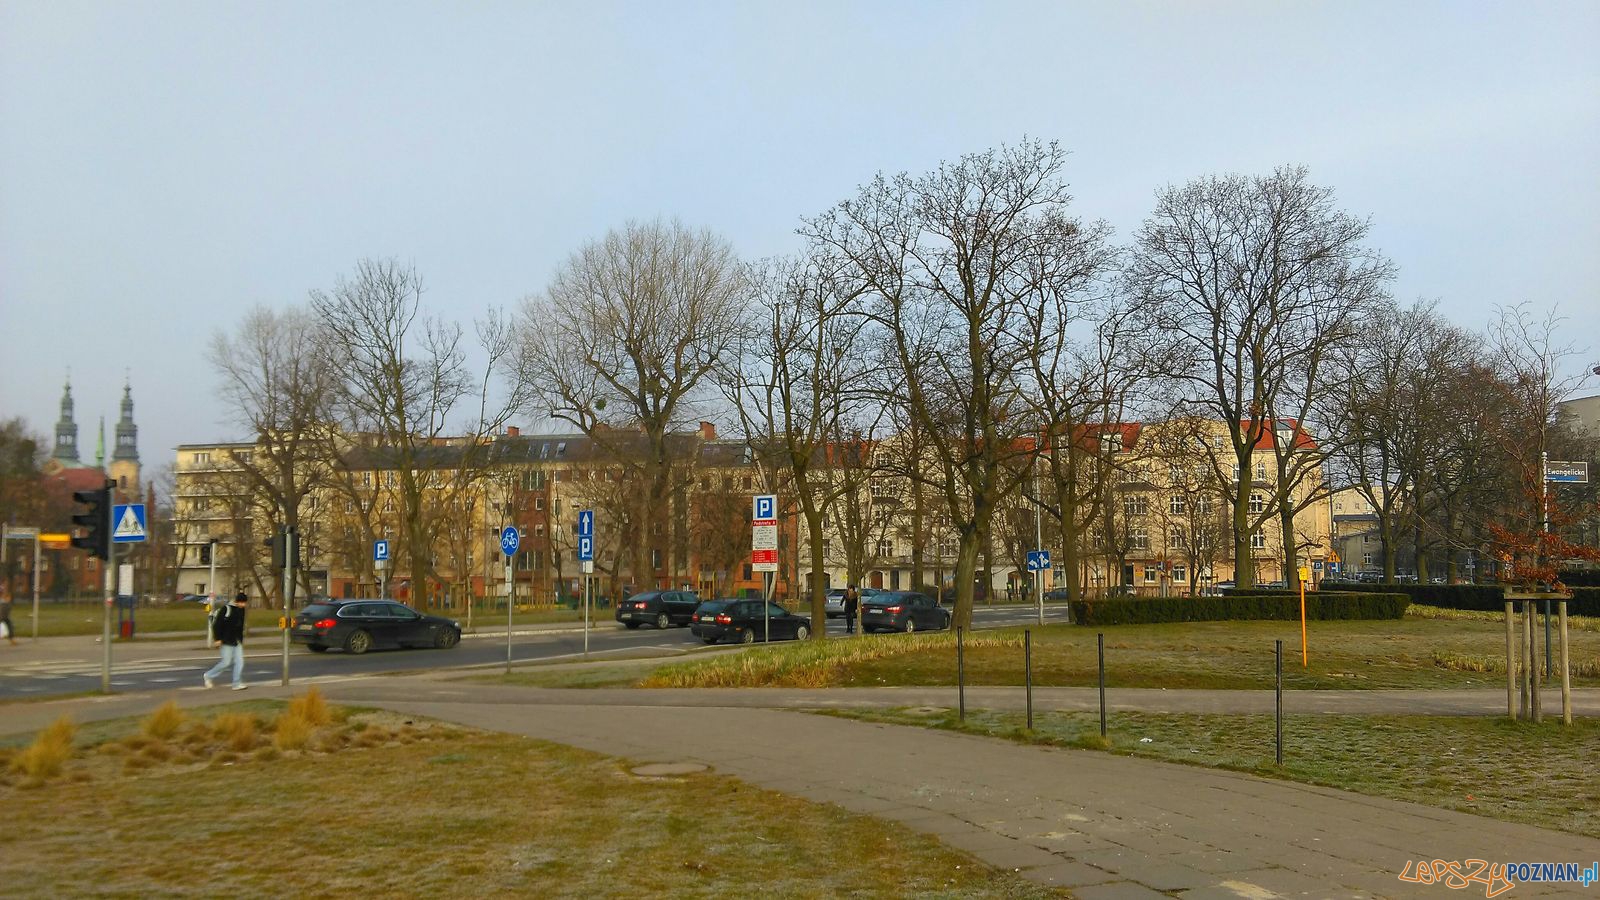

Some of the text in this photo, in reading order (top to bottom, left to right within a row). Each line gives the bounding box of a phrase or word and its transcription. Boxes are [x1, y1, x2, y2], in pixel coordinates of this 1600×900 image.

[1547, 468, 1585, 476] Ewangelicka
[759, 499, 770, 517] P
[377, 543, 386, 559] P
[581, 538, 590, 558] P
